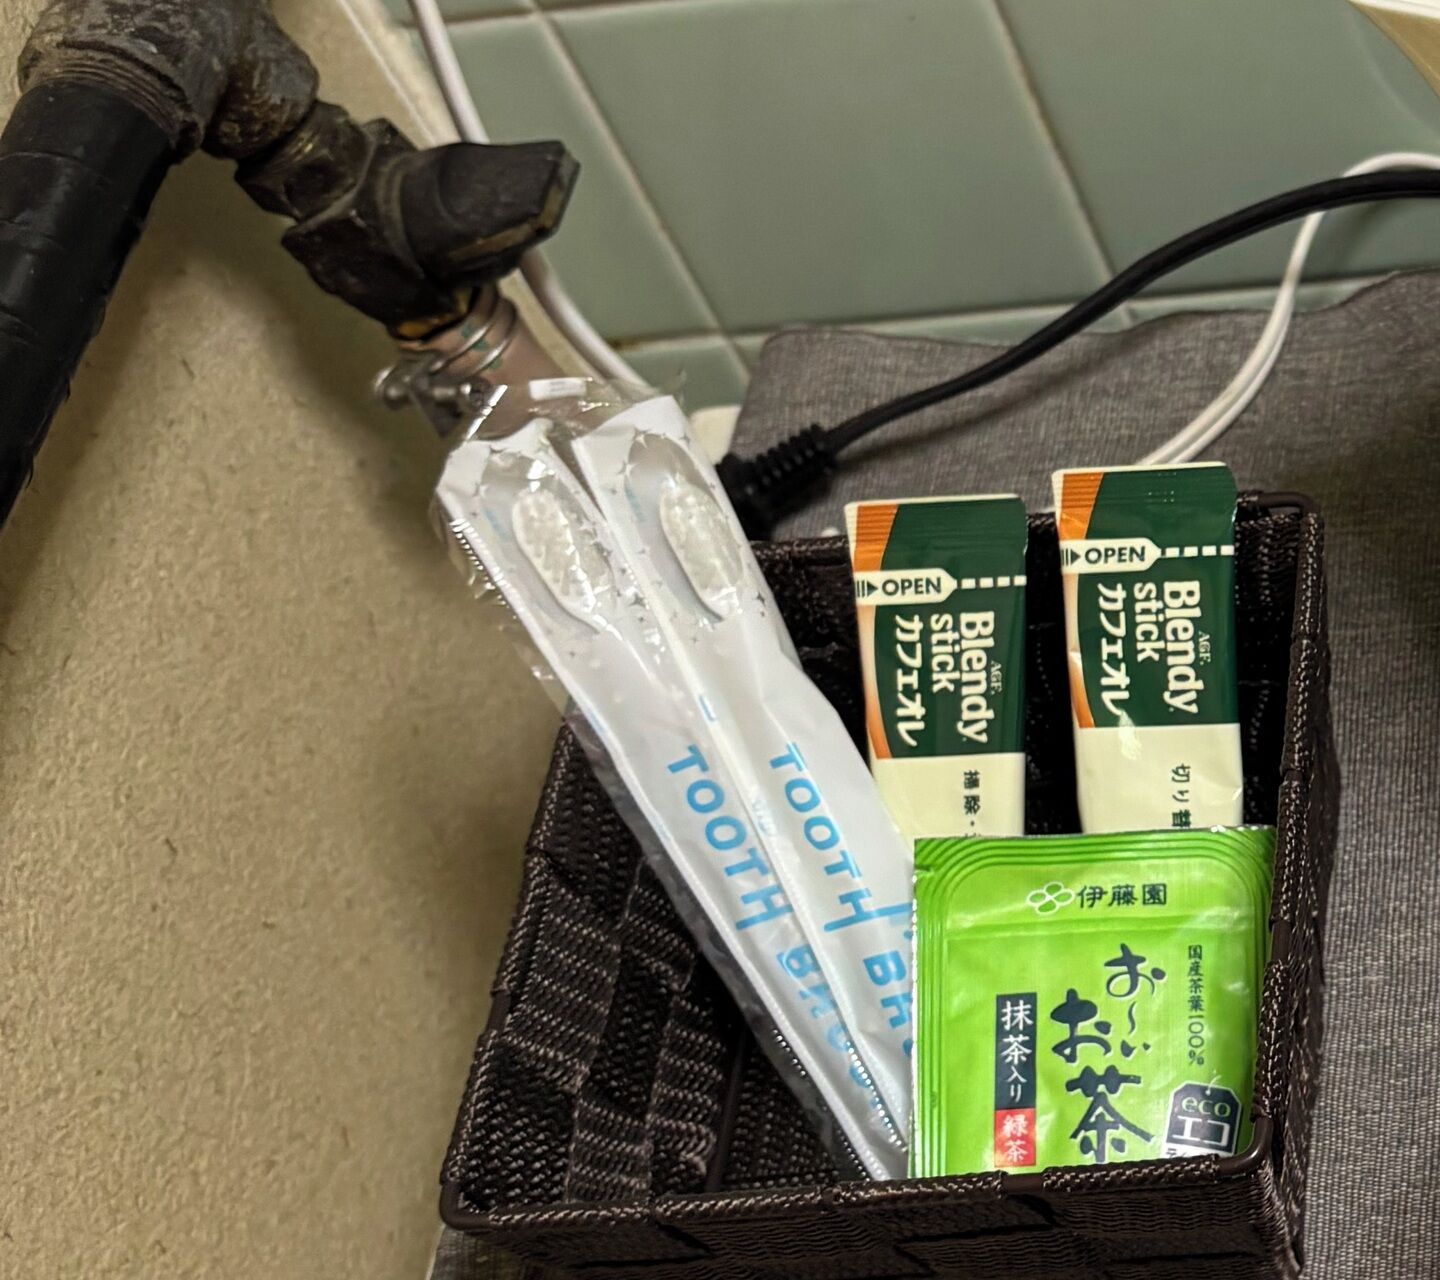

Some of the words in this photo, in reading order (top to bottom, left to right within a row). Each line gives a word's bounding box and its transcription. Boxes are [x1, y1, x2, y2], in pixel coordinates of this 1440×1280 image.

[881, 577, 942, 597] OPEN
[1084, 545, 1146, 565] OPEN
[930, 613, 961, 694] stick
[1097, 582, 1132, 718] カフェオレ
[1133, 581, 1165, 663] stick
[1163, 580, 1205, 714] Blendy
[895, 613, 926, 747] カフェオレ
[956, 610, 995, 744] Blendy
[666, 744, 793, 931] TOOTH
[768, 742, 912, 932] TOOTH
[1077, 882, 1167, 908] 伊藤園
[1000, 999, 1034, 1104] 抹茶入り
[1001, 1113, 1029, 1163] 緑茶
[1172, 1115, 1231, 1147] エコ
[1181, 1096, 1231, 1117] eco
